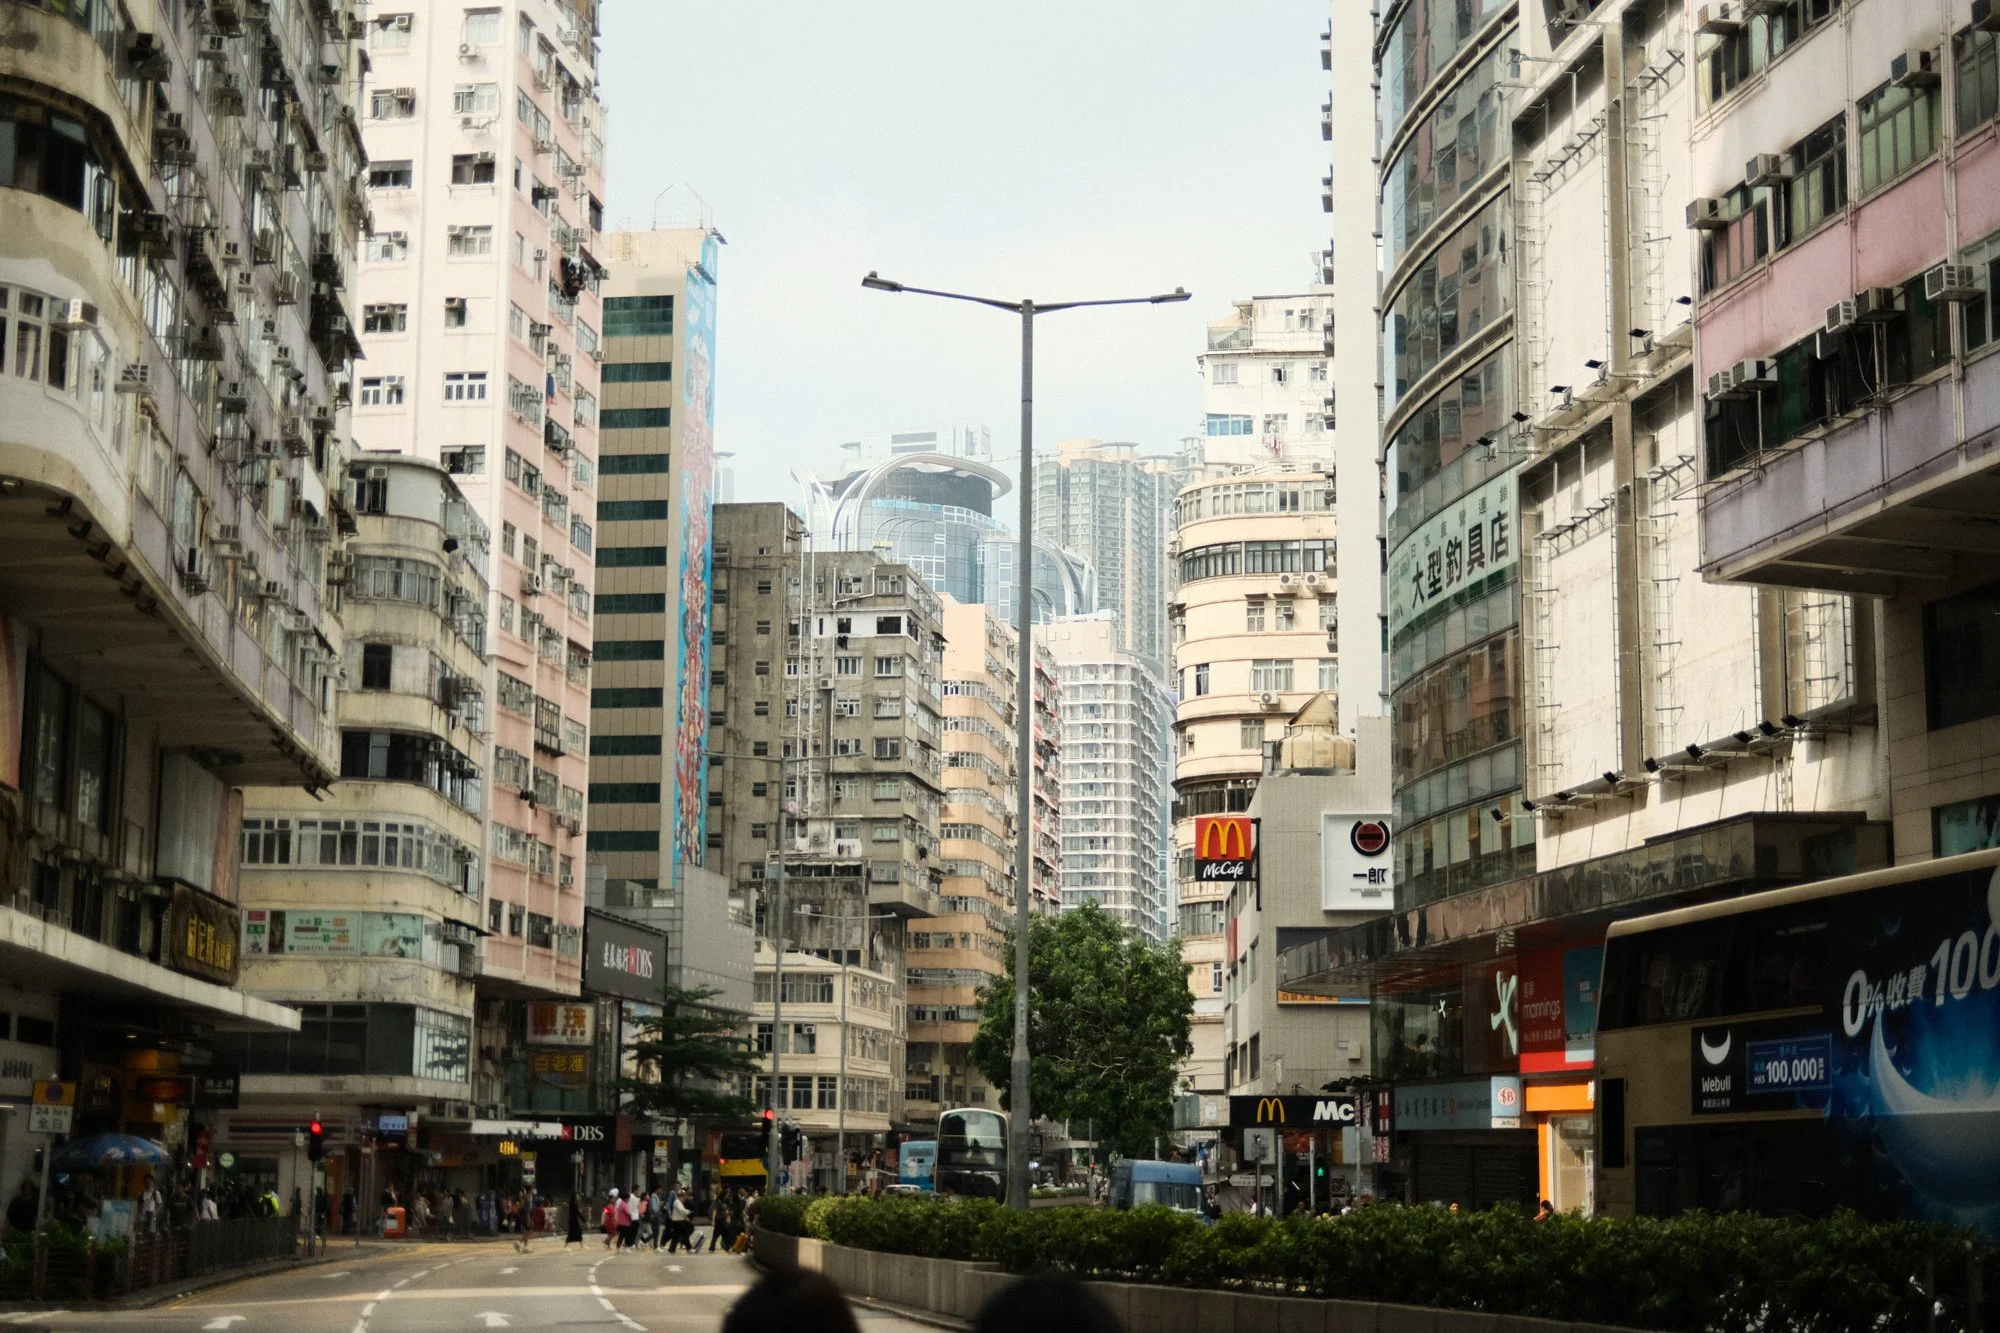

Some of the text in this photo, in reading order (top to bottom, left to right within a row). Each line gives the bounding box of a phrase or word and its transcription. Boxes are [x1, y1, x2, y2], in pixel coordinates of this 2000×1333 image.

[1411, 510, 1510, 609] 大型釣具店
[1202, 860, 1245, 879] McCafé
[1352, 866, 1389, 885] 一郎
[636, 947, 653, 980] DBS
[1523, 998, 1561, 1021] mannings
[1765, 1057, 1817, 1086] 100,000
[1701, 1075, 1731, 1093] Webull
[35, 1106, 69, 1117] 24 hrs
[37, 1118, 63, 1131] 全日
[573, 1125, 605, 1141] DBS
